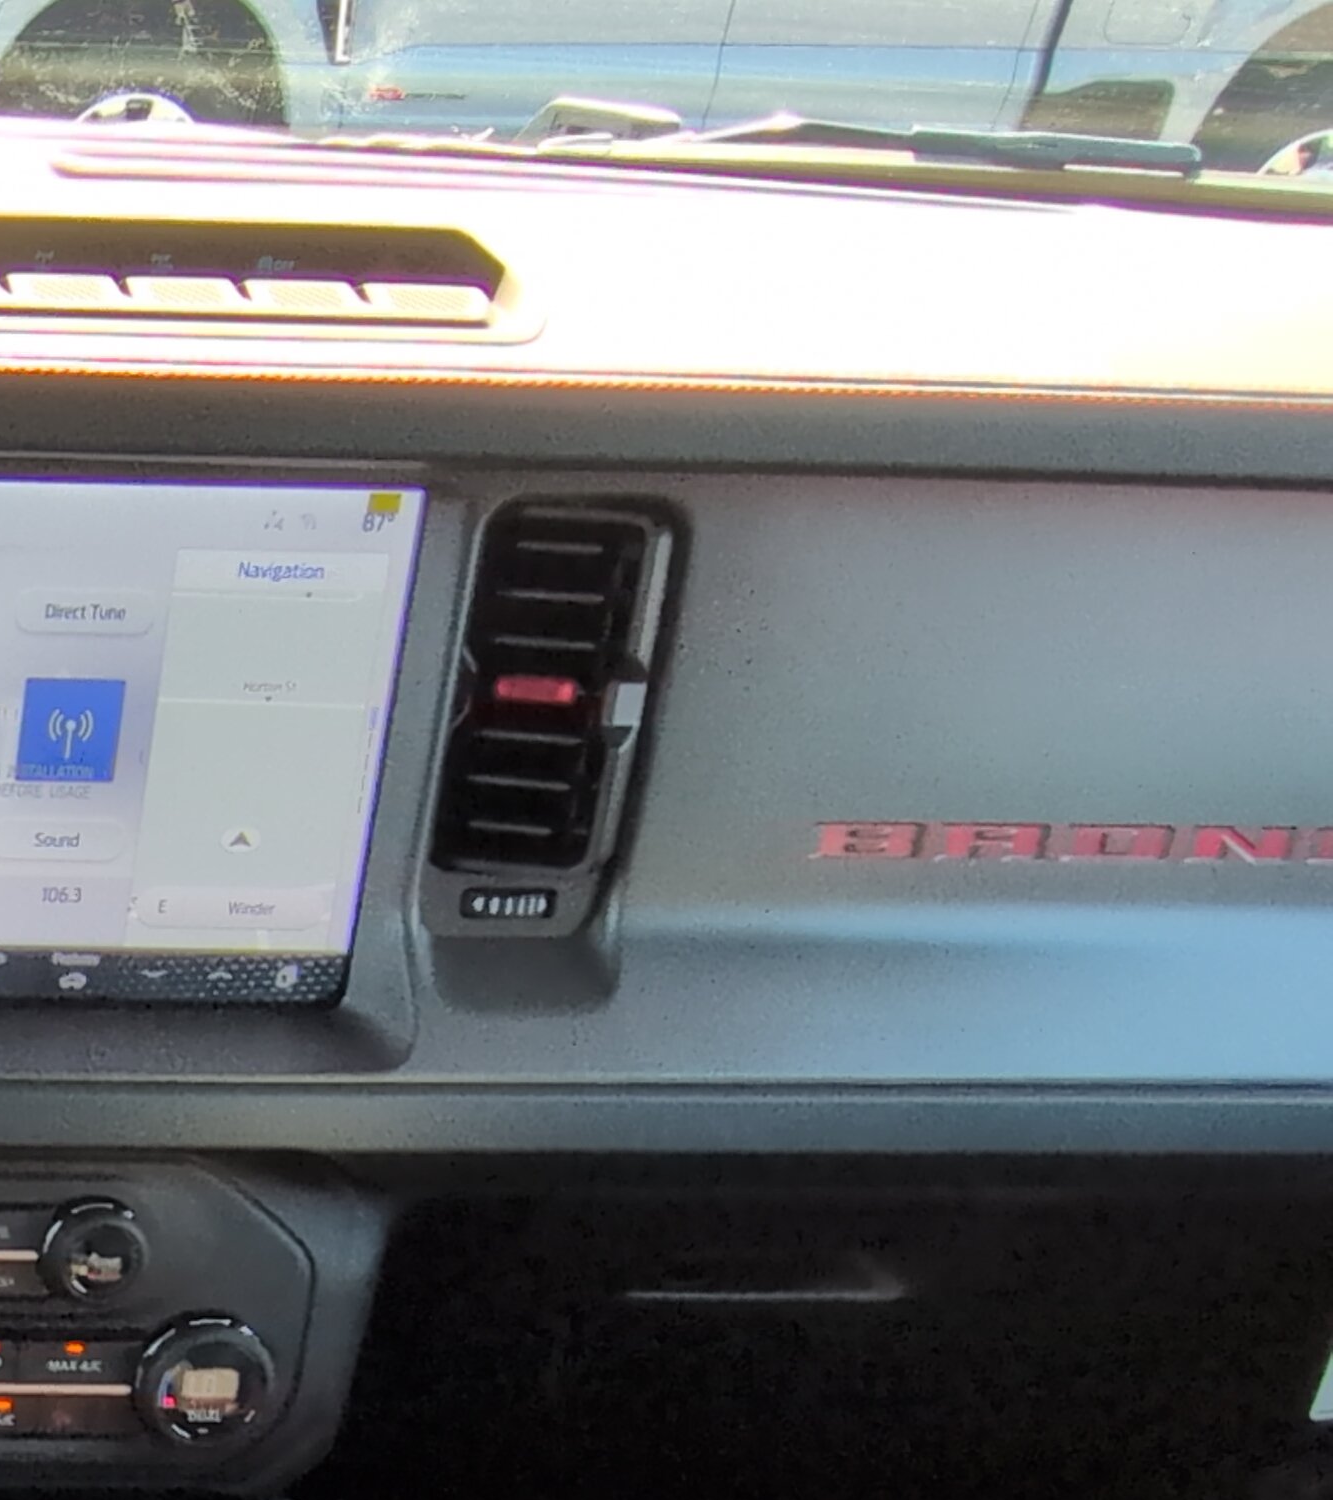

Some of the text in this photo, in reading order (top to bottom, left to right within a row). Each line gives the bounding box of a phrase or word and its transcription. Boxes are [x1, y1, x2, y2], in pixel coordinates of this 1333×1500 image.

[237, 561, 325, 582] Navigation
[44, 603, 127, 621] Direct Tune
[50, 783, 92, 800] USAGE
[33, 832, 81, 849] Sound
[809, 820, 1333, 865] BRON
[41, 886, 82, 904] 106.3
[228, 901, 276, 917] Winder
[47, 1359, 78, 1373] MAX
